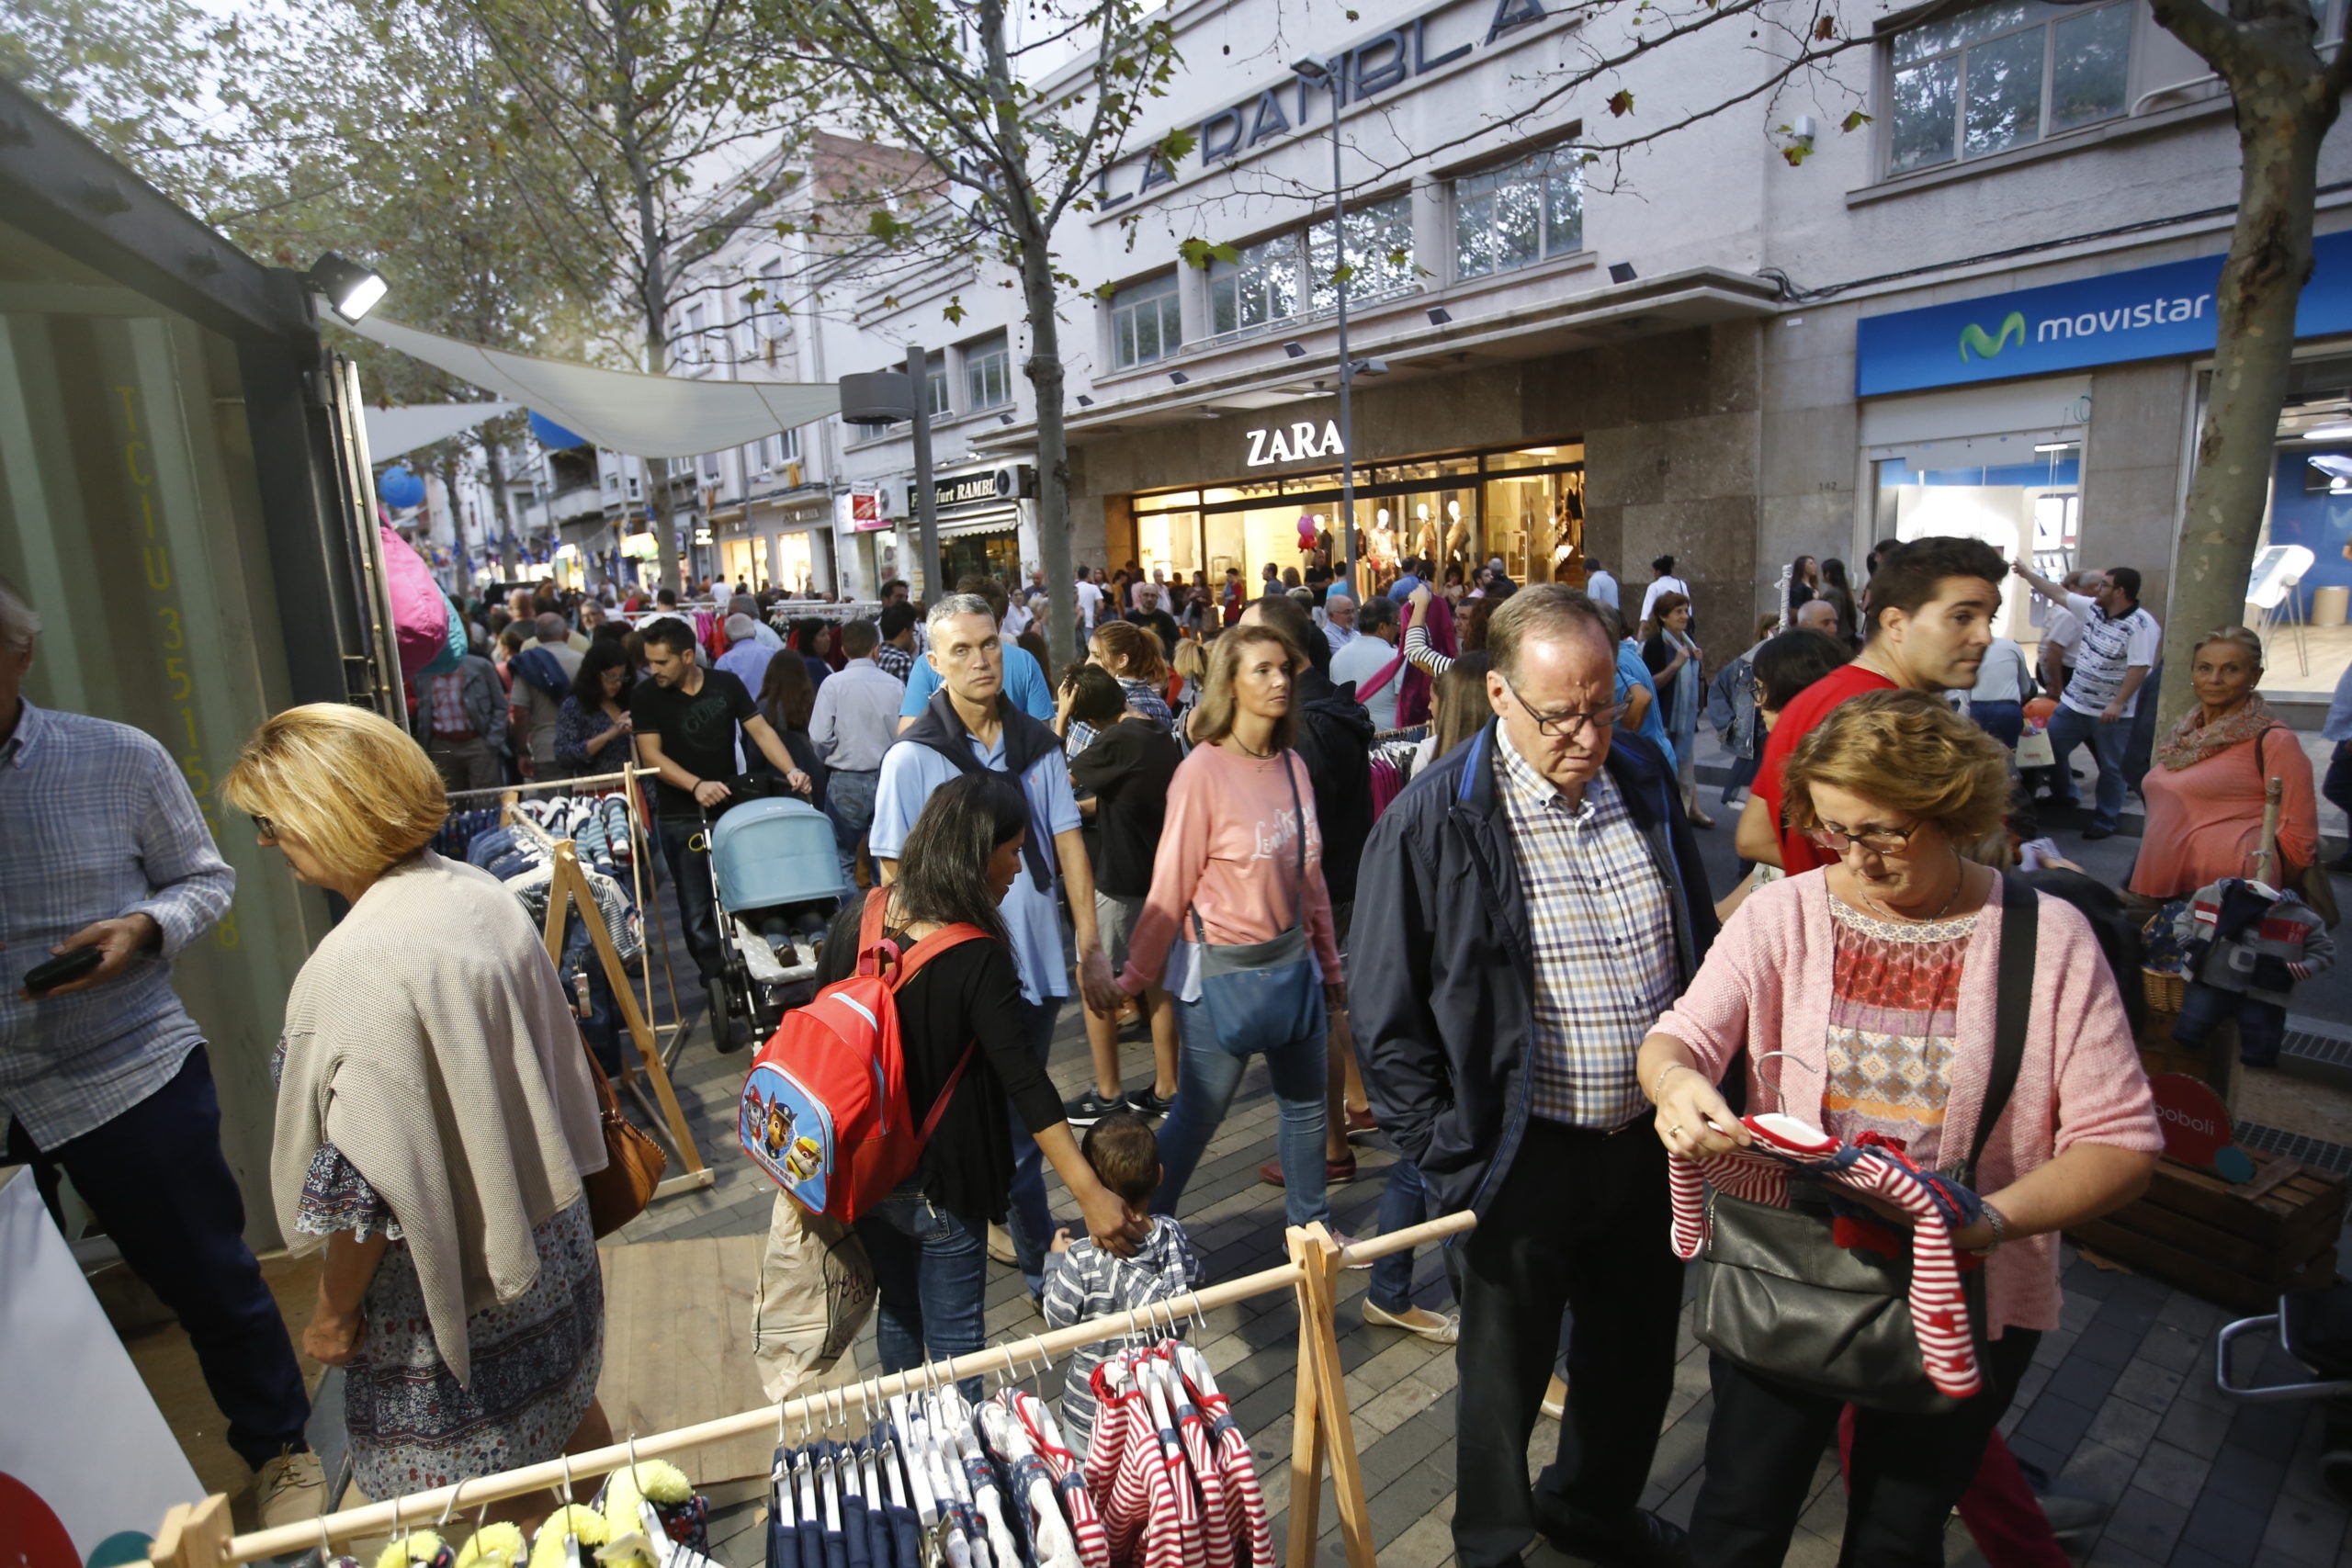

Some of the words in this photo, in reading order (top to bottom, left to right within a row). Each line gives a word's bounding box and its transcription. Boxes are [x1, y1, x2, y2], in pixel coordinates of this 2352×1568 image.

[1200, 0, 1549, 167] RAMBLA
[2037, 294, 2211, 343] movistar
[1246, 419, 1345, 467] ZARA
[116, 386, 172, 591] TCIU
[956, 478, 995, 501] RAMBL
